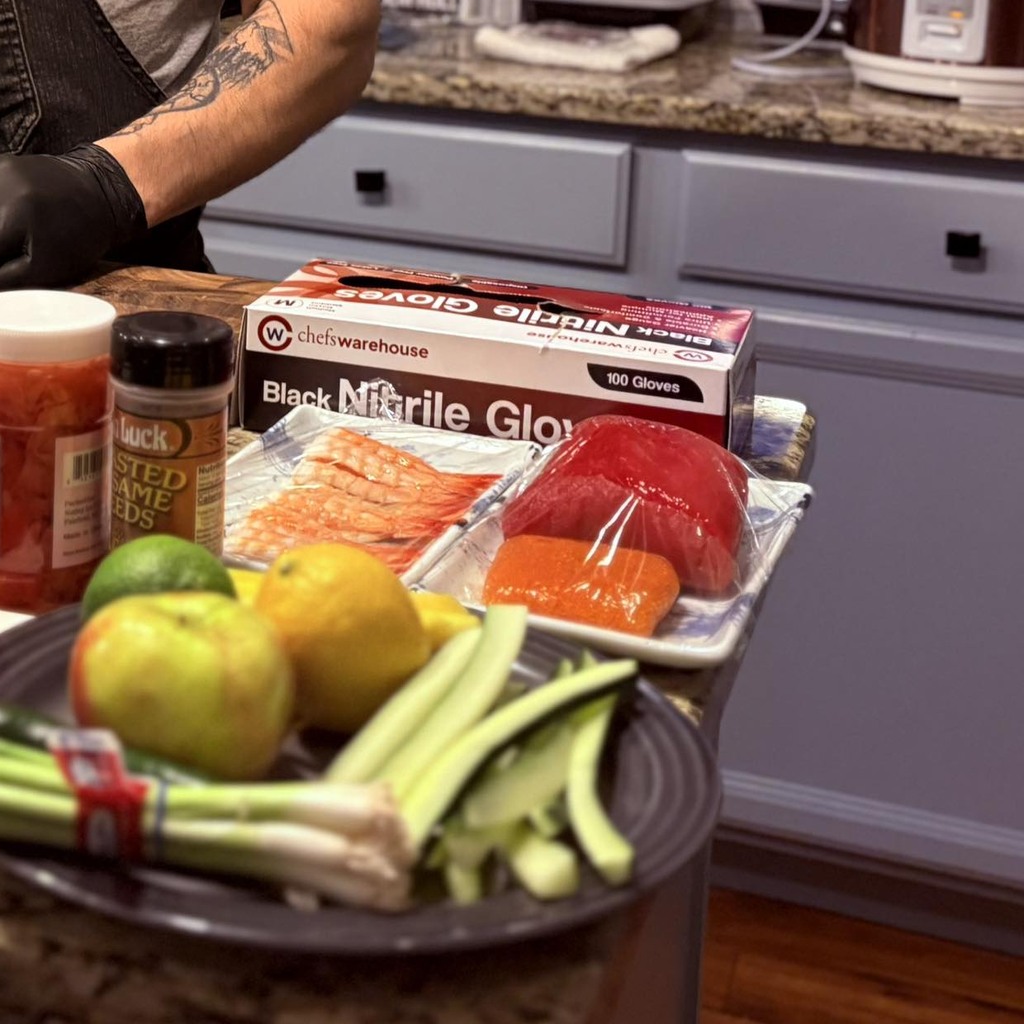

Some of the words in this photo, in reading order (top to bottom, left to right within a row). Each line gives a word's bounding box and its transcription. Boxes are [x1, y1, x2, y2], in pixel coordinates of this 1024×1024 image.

[333, 289, 479, 314] Gloves
[636, 326, 713, 347] Black
[263, 380, 332, 411] Black
[607, 372, 629, 387] 100
[632, 376, 680, 394] Gloves
[114, 451, 188, 491] STED
